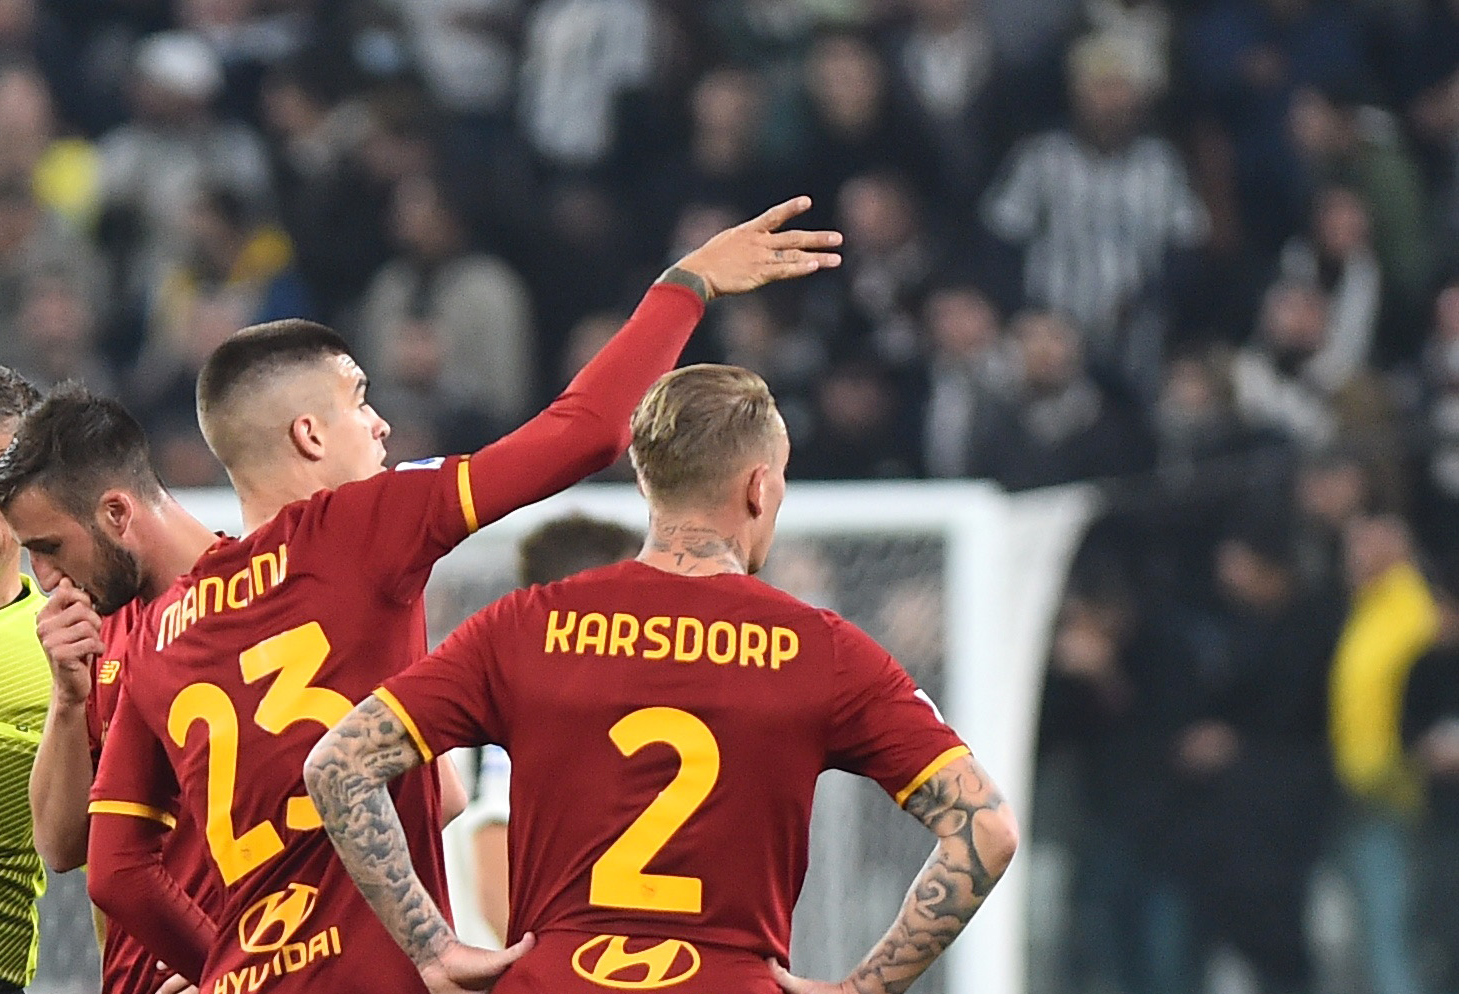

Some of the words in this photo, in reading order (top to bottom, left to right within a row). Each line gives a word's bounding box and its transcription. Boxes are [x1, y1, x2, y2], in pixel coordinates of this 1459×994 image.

[543, 609, 800, 670] KARSDORP
[167, 620, 355, 888] 23
[588, 705, 721, 914] 2
